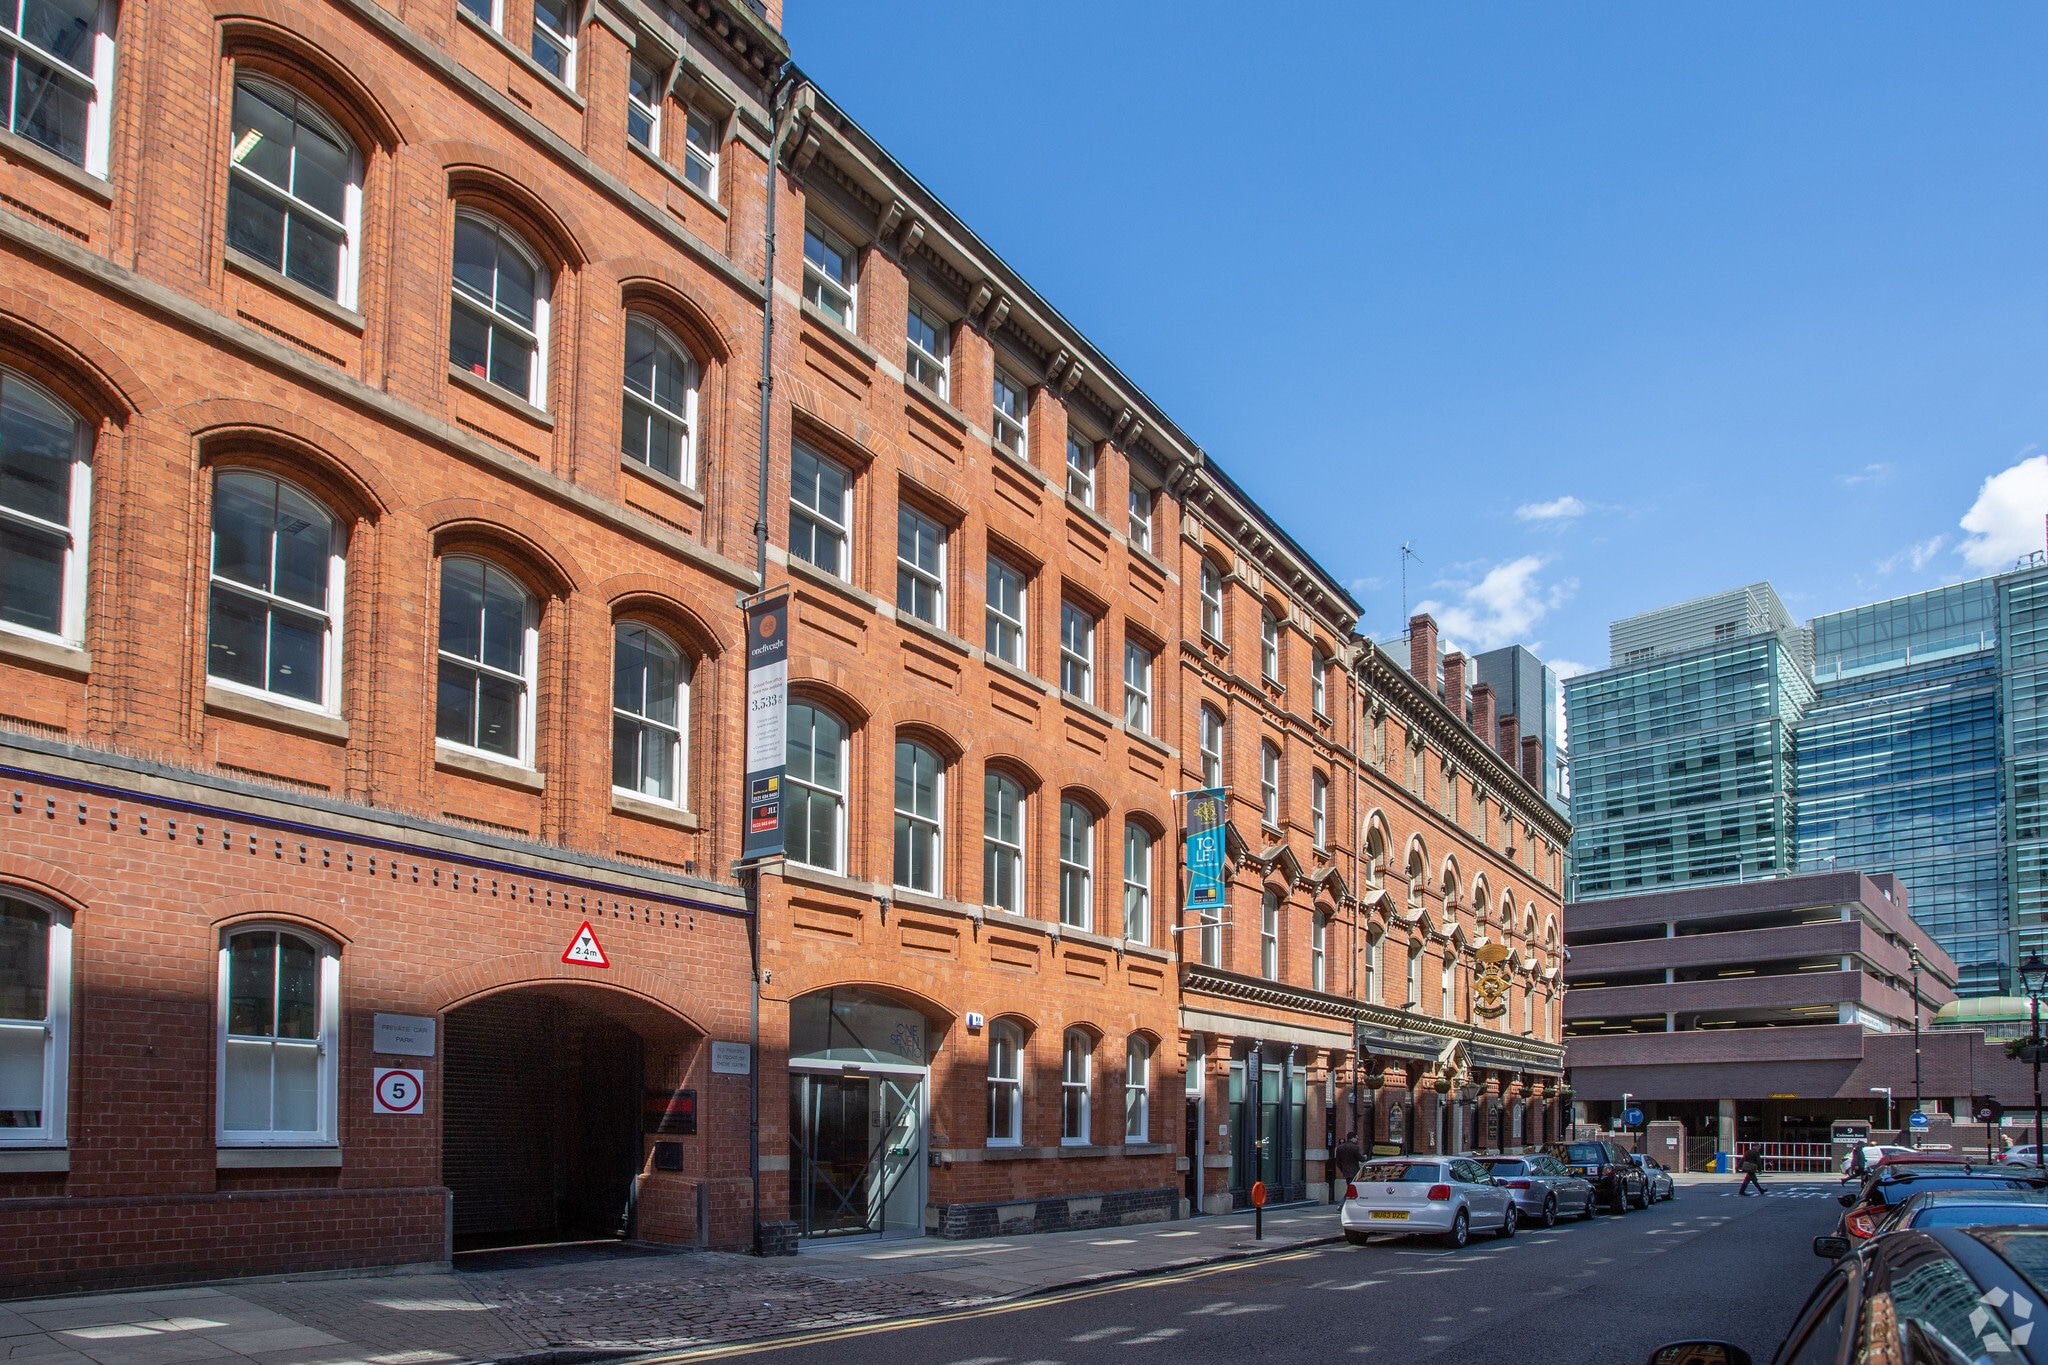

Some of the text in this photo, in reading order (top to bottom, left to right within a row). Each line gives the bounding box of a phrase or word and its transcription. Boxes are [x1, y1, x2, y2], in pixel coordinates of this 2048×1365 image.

[1197, 836, 1214, 850] TO
[1196, 848, 1216, 862] LET
[576, 946, 597, 956] 2.4m
[382, 1024, 410, 1032] PRIVATE
[896, 1024, 918, 1036] ONE
[890, 1034, 920, 1046] SEVEN
[392, 1083, 405, 1099] 5
